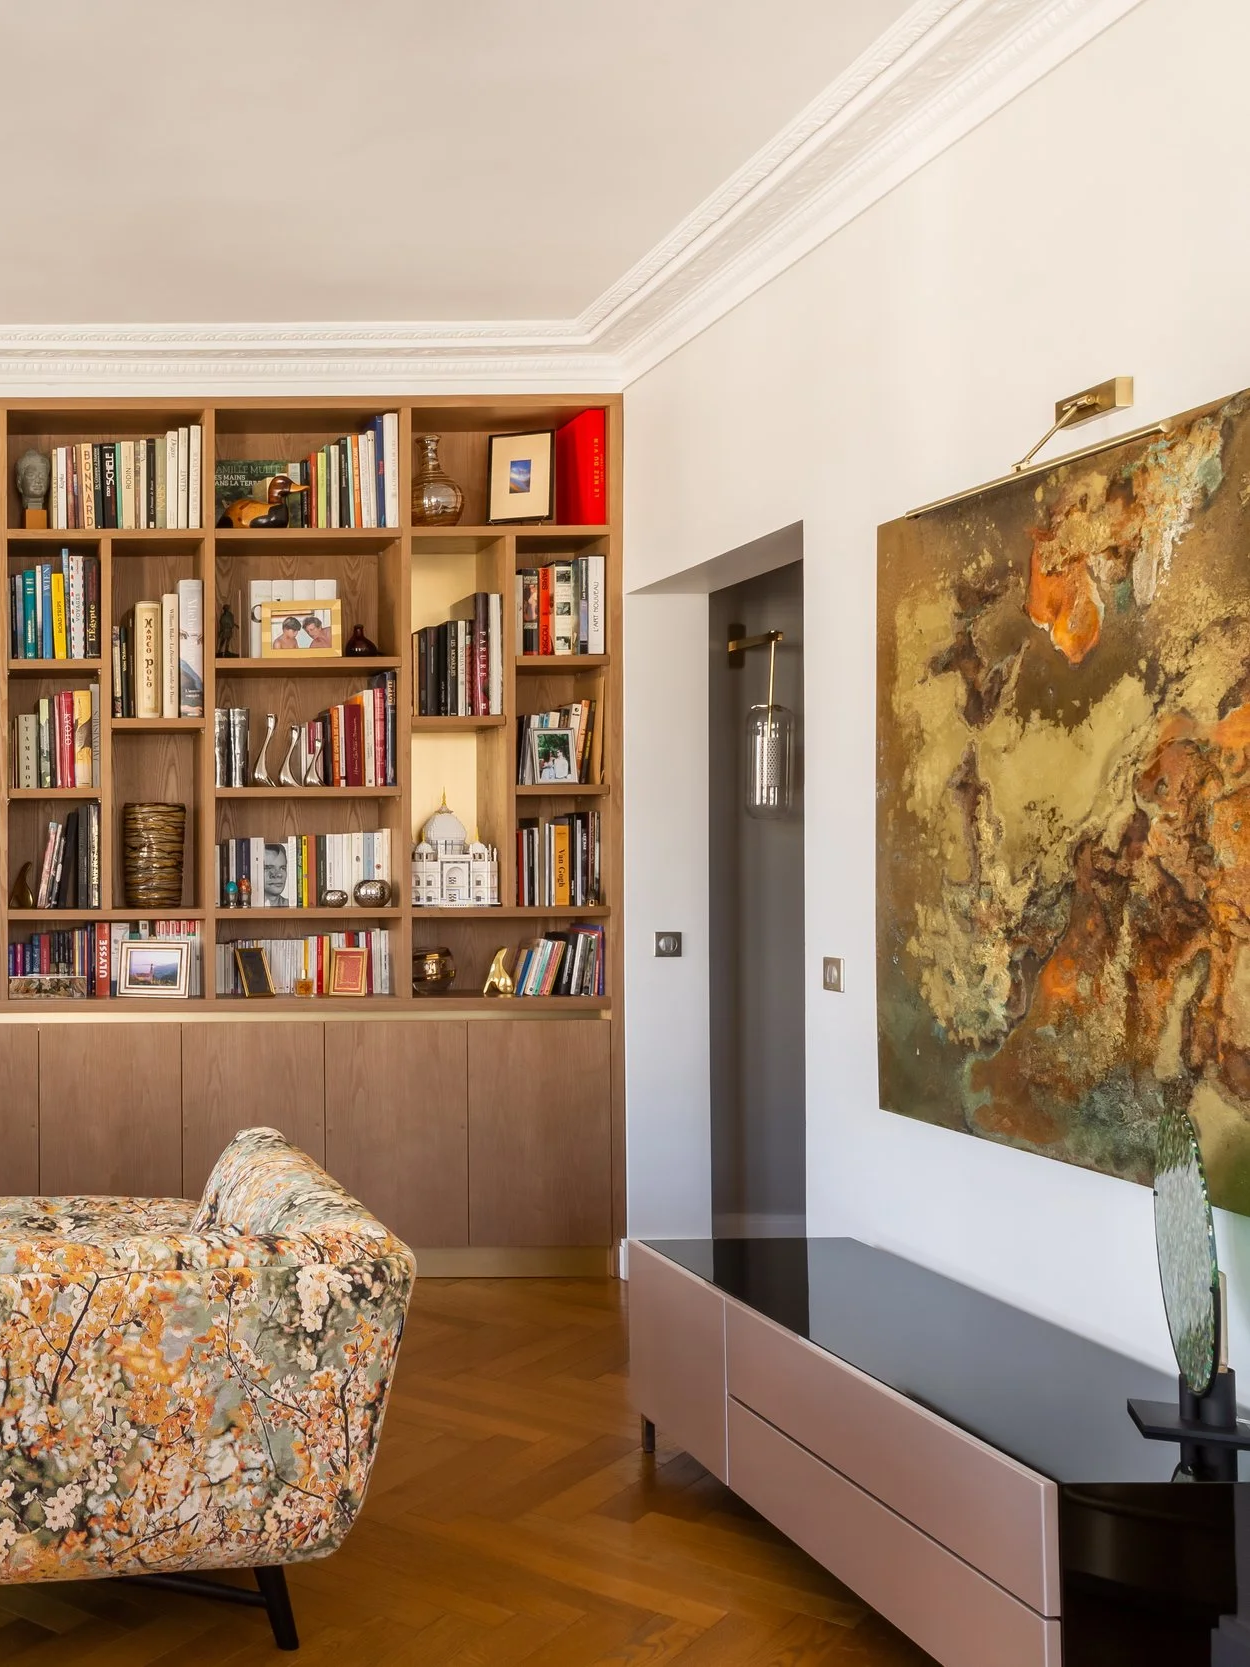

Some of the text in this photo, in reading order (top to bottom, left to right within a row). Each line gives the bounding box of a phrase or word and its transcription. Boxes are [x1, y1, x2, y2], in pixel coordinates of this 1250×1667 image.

[105, 452, 115, 486] SCHIELE
[215, 465, 248, 474] AMILLE
[84, 451, 94, 527] BONNARD
[594, 489, 600, 498] LE
[43, 567, 51, 591] WIEN
[86, 604, 97, 642] L'Égypte
[144, 618, 154, 688] MARCO POLO
[479, 631, 487, 678] PARURE
[64, 713, 73, 746] KYOTO
[92, 710, 100, 762] JAPONISMES
[557, 866, 566, 888] Gogh
[99, 939, 108, 978] ULYSSE
